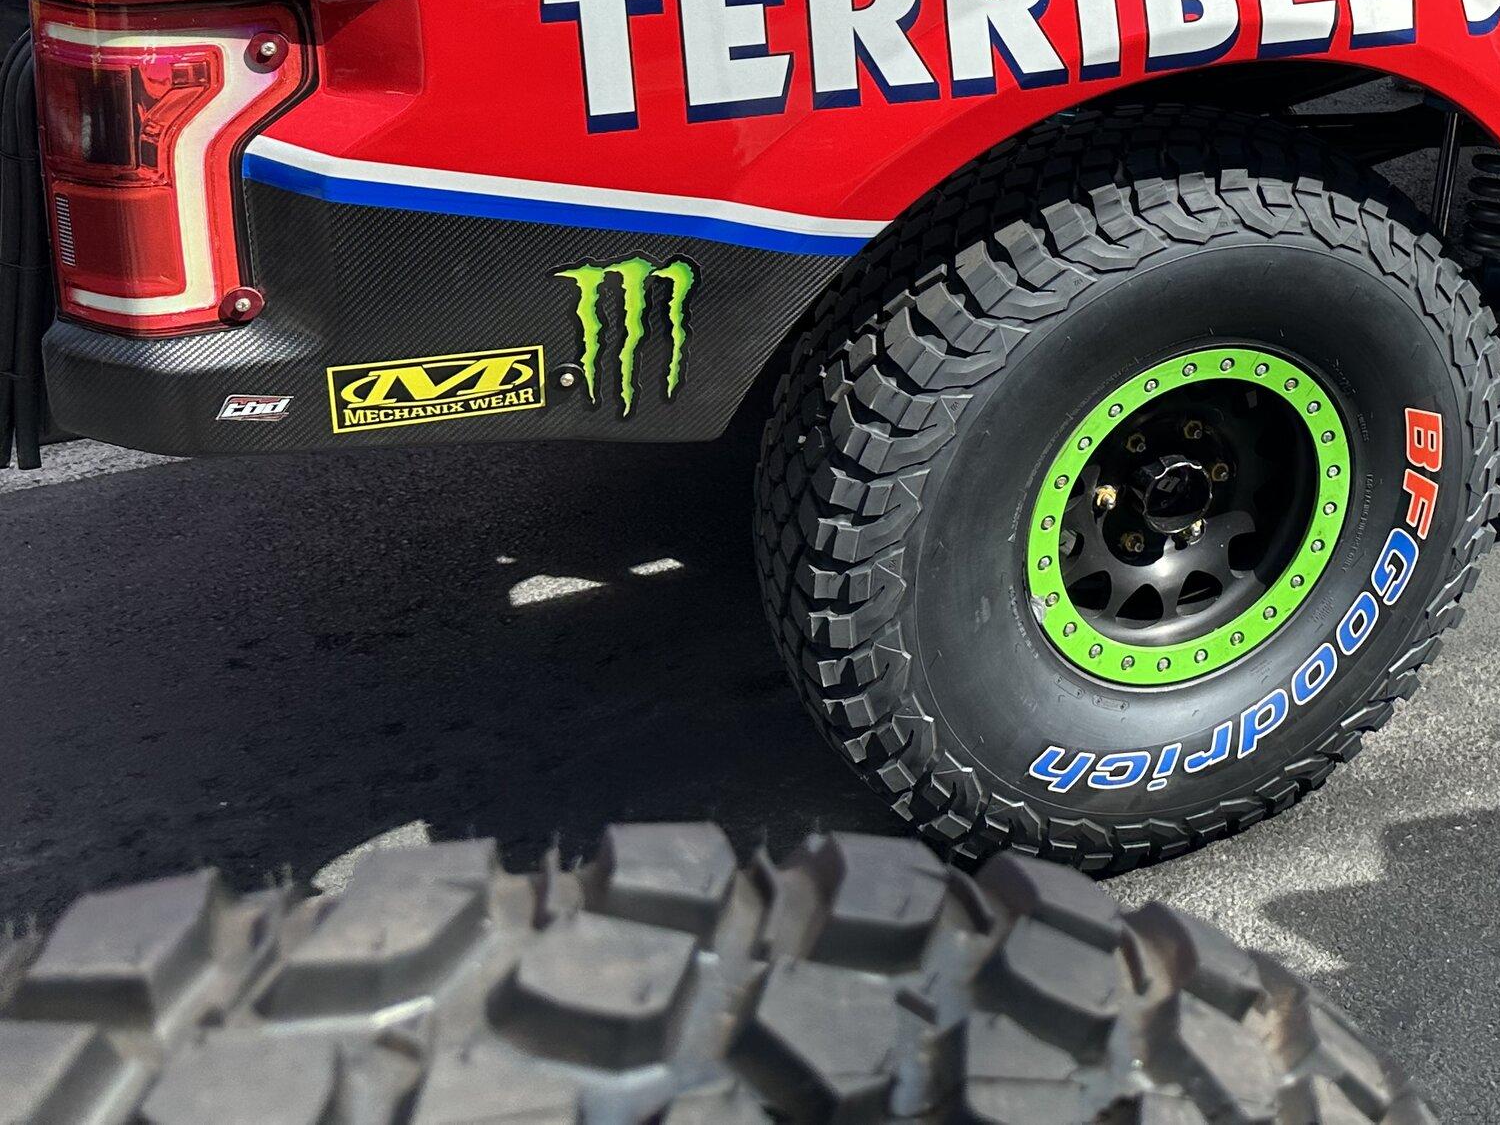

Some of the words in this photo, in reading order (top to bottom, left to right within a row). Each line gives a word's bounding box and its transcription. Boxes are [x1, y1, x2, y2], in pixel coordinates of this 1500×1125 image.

[343, 400, 464, 427] MECHANIX
[469, 386, 535, 411] WEAR
[1029, 407, 1443, 793] BFGoodrich
